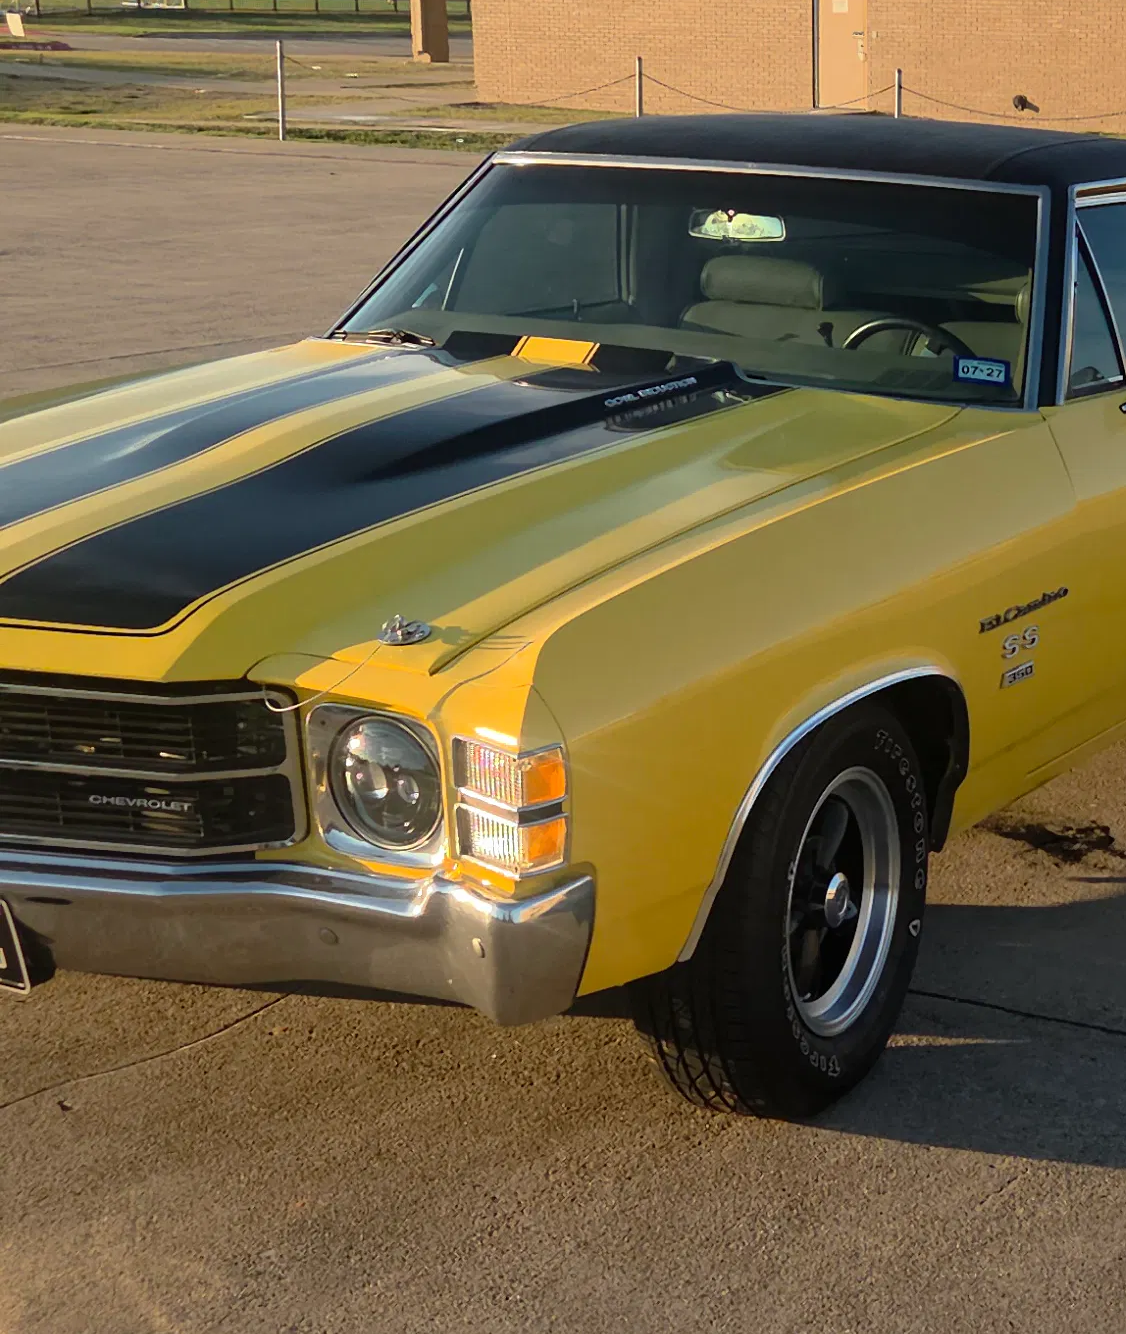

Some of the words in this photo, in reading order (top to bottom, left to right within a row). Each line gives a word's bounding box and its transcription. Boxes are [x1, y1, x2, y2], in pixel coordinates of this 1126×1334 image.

[1001, 625, 1040, 659] SS
[1007, 665, 1034, 684] 350
[88, 794, 192, 813] CHEVROLET
